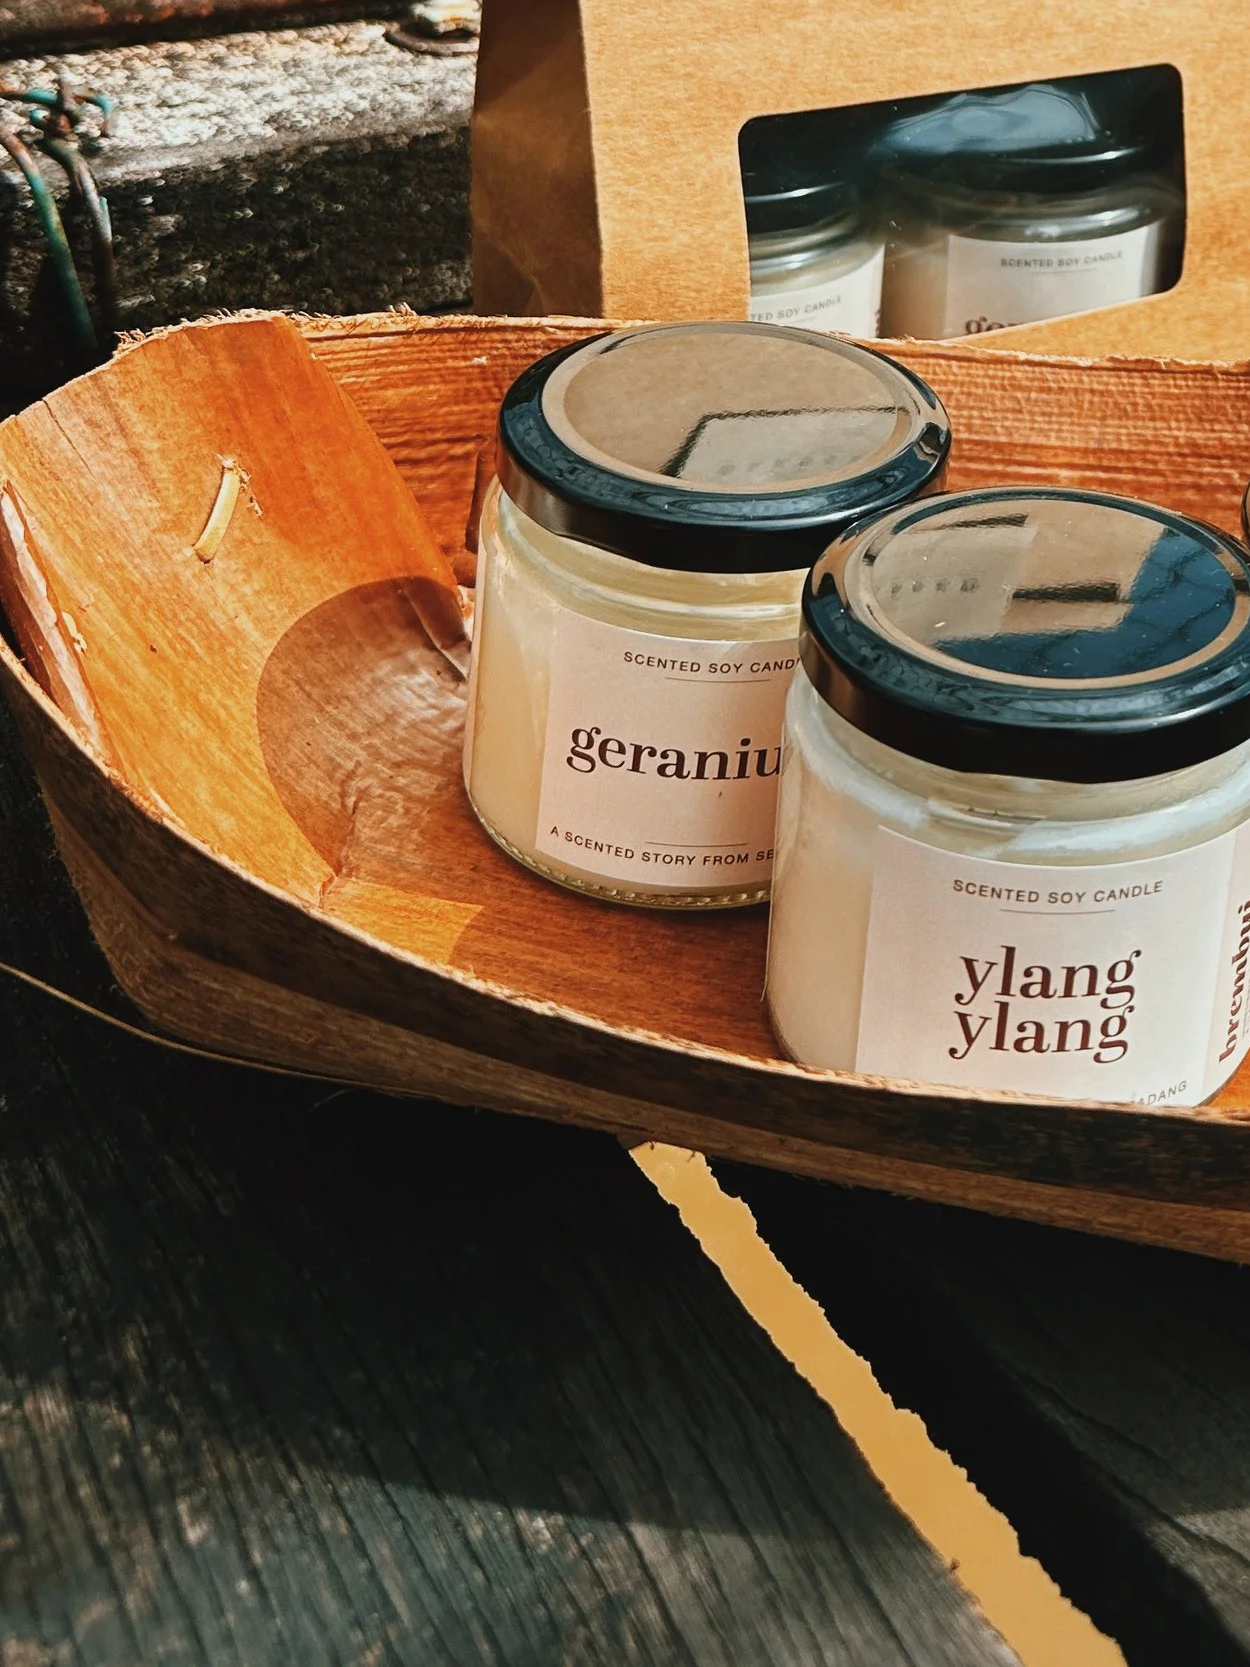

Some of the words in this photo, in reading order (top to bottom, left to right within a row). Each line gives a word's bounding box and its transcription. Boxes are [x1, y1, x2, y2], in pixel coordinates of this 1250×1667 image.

[1000, 257, 1054, 268] SCENTED
[1058, 256, 1079, 267] SOY
[1084, 250, 1123, 265] CANDLE
[777, 306, 801, 319] SOY
[804, 295, 842, 314] CANDLE
[623, 651, 701, 673] SCENTED
[708, 662, 743, 674] SOY
[750, 657, 800, 673] CAND
[566, 726, 782, 781] geraniu
[550, 826, 560, 837] A
[564, 831, 635, 860] SCENTED
[641, 852, 697, 866] STORY
[702, 852, 749, 866] FROM
[952, 879, 1040, 903] SCENTED
[1048, 891, 1087, 905] SOY
[1094, 880, 1164, 903] CANDLE
[954, 945, 1142, 1009] ylang
[948, 1001, 1135, 1064] ylang
